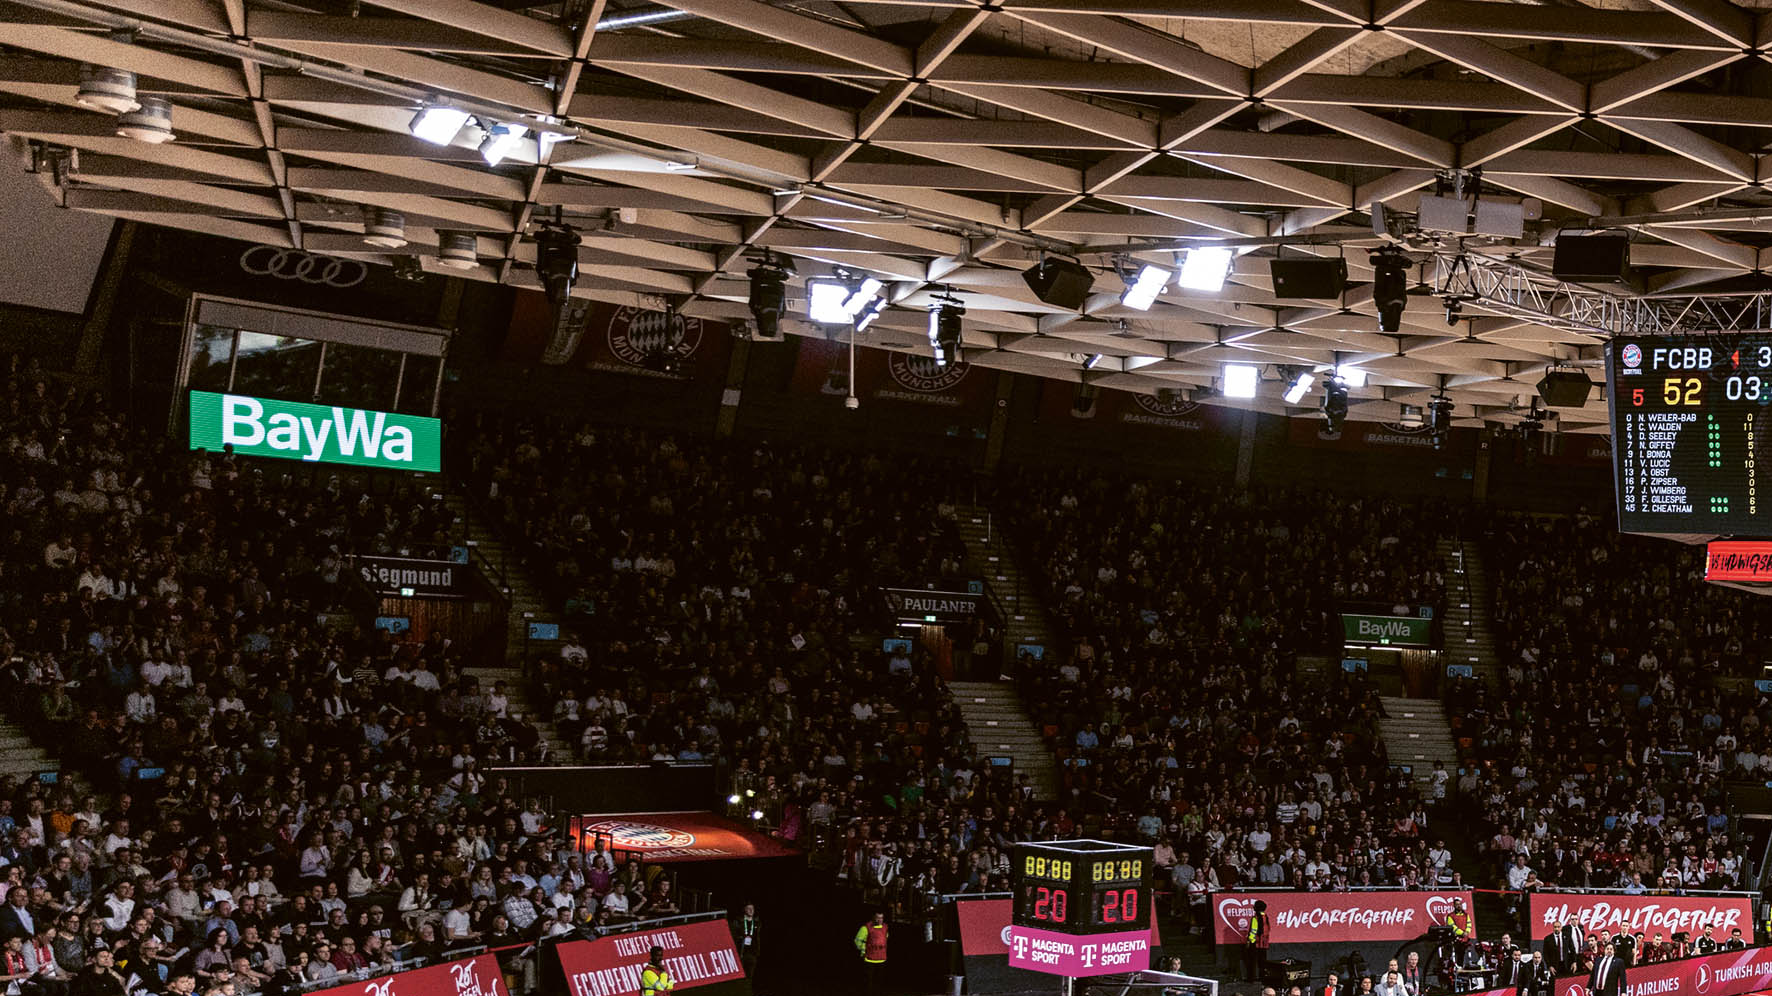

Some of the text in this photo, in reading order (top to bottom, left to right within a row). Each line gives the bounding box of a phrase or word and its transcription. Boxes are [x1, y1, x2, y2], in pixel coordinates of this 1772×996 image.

[1653, 348, 1712, 369] FCBB
[1758, 346, 1772, 367] 3
[1633, 389, 1644, 406] 5
[1664, 378, 1702, 405] 52
[222, 394, 413, 461] BayWa
[1648, 423, 1681, 431] WALDEN
[1649, 432, 1677, 440] SEELEY
[905, 598, 976, 613] PAULANER
[1359, 620, 1411, 637] BayWa
[1035, 887, 1137, 922] 20 20
[614, 936, 651, 958] TICKETS
[1032, 939, 1074, 955] MAGENTA
[1102, 940, 1146, 953] MAGENTA
[1032, 951, 1059, 964] SPORT
[1101, 953, 1131, 966] SPORT
[450, 960, 475, 992] ROT
[1715, 965, 1753, 983] TURKISH
